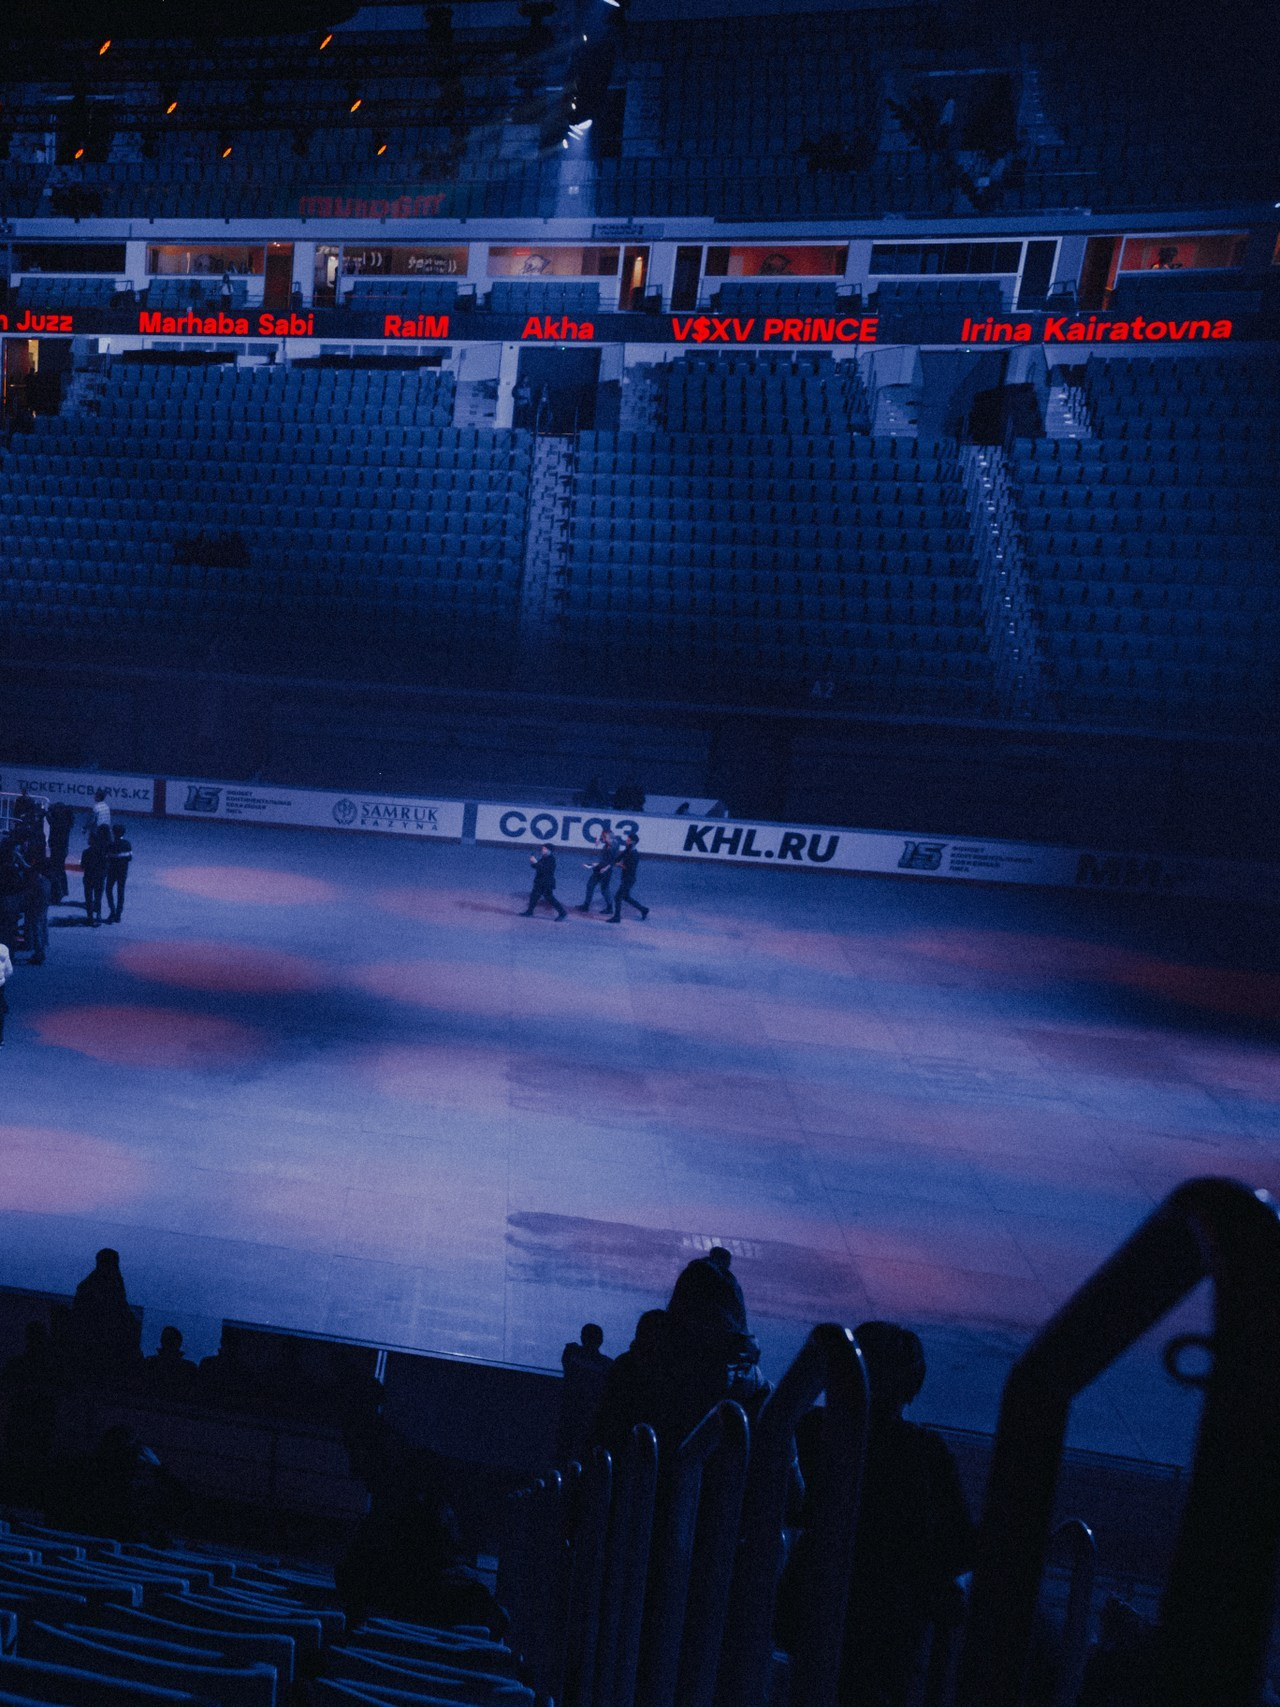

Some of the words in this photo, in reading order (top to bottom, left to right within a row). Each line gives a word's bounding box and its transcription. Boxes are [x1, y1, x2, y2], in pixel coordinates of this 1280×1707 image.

[16, 309, 73, 332] Juzz
[139, 312, 249, 334] Marhaba
[258, 313, 314, 336] Sabi
[383, 315, 449, 338] RaiM
[521, 316, 595, 340] Akha
[671, 316, 755, 342] V$XV
[961, 318, 1033, 342] Irina
[1043, 315, 1233, 342] Kairatovna
[361, 802, 438, 822] SAMRUK
[361, 818, 439, 831] KAZYNA
[683, 824, 840, 863] KHL.RU
